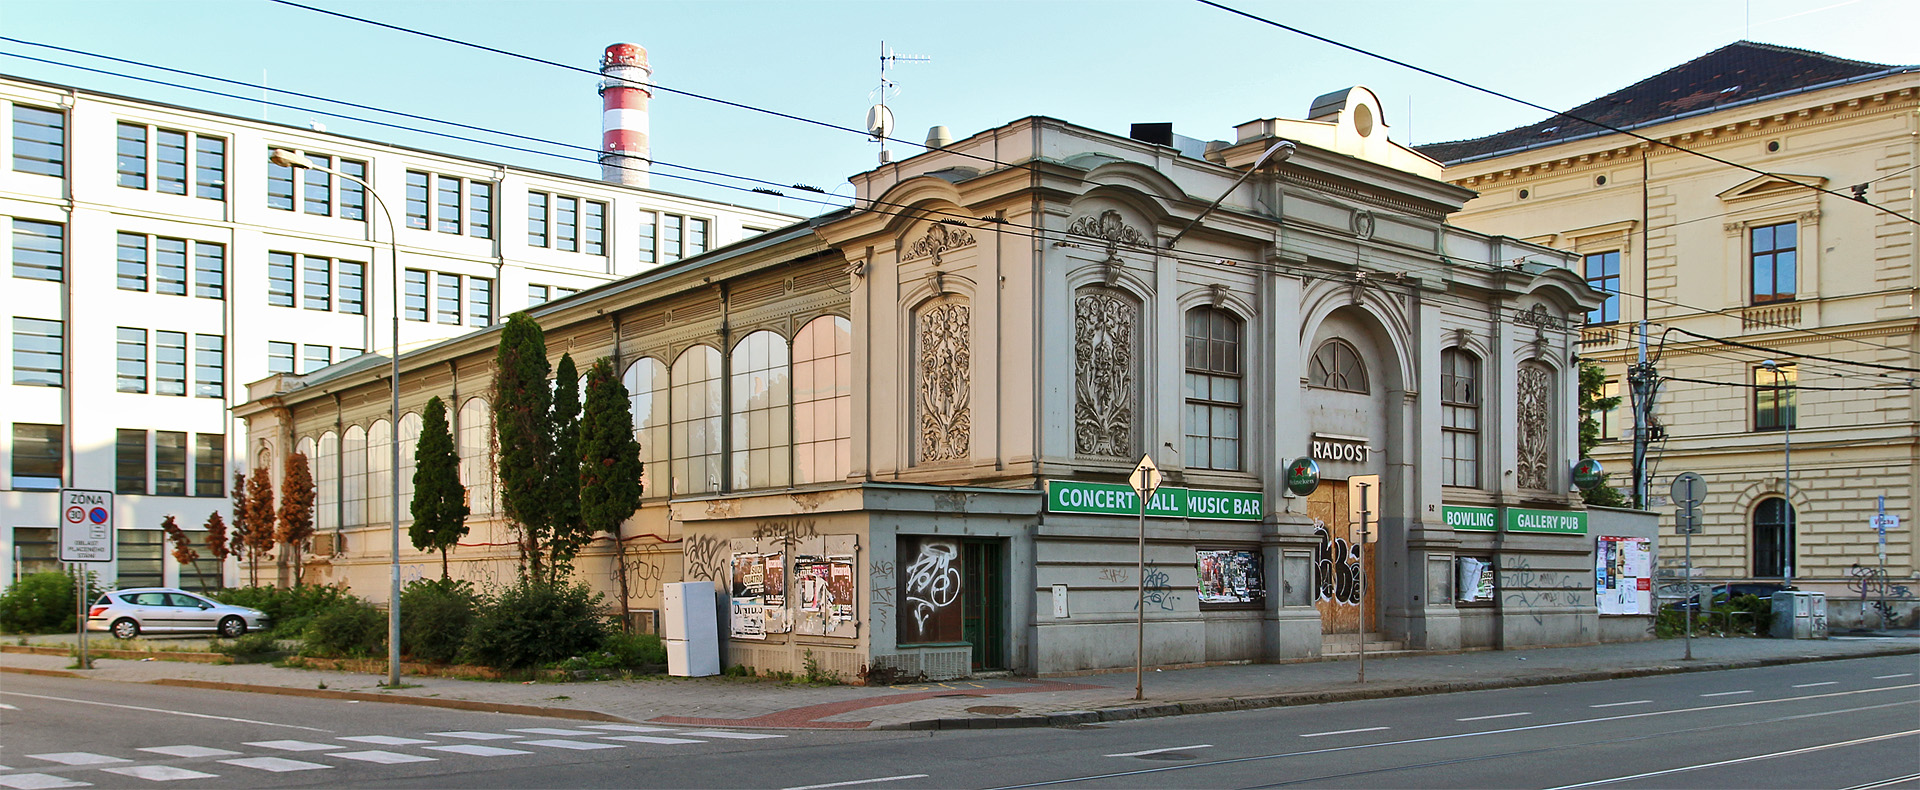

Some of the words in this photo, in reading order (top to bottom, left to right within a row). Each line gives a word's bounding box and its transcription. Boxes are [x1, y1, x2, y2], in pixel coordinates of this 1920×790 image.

[1313, 440, 1372, 462] RADOST
[70, 492, 103, 504] ZÓNA
[1059, 488, 1135, 509] CONCERT
[1187, 496, 1229, 514] MUSIC
[1233, 498, 1260, 515] BAR
[70, 510, 81, 519] 30
[1446, 511, 1494, 526] BOWLING
[1517, 514, 1558, 529] GALLERY
[1560, 516, 1579, 529] PUB
